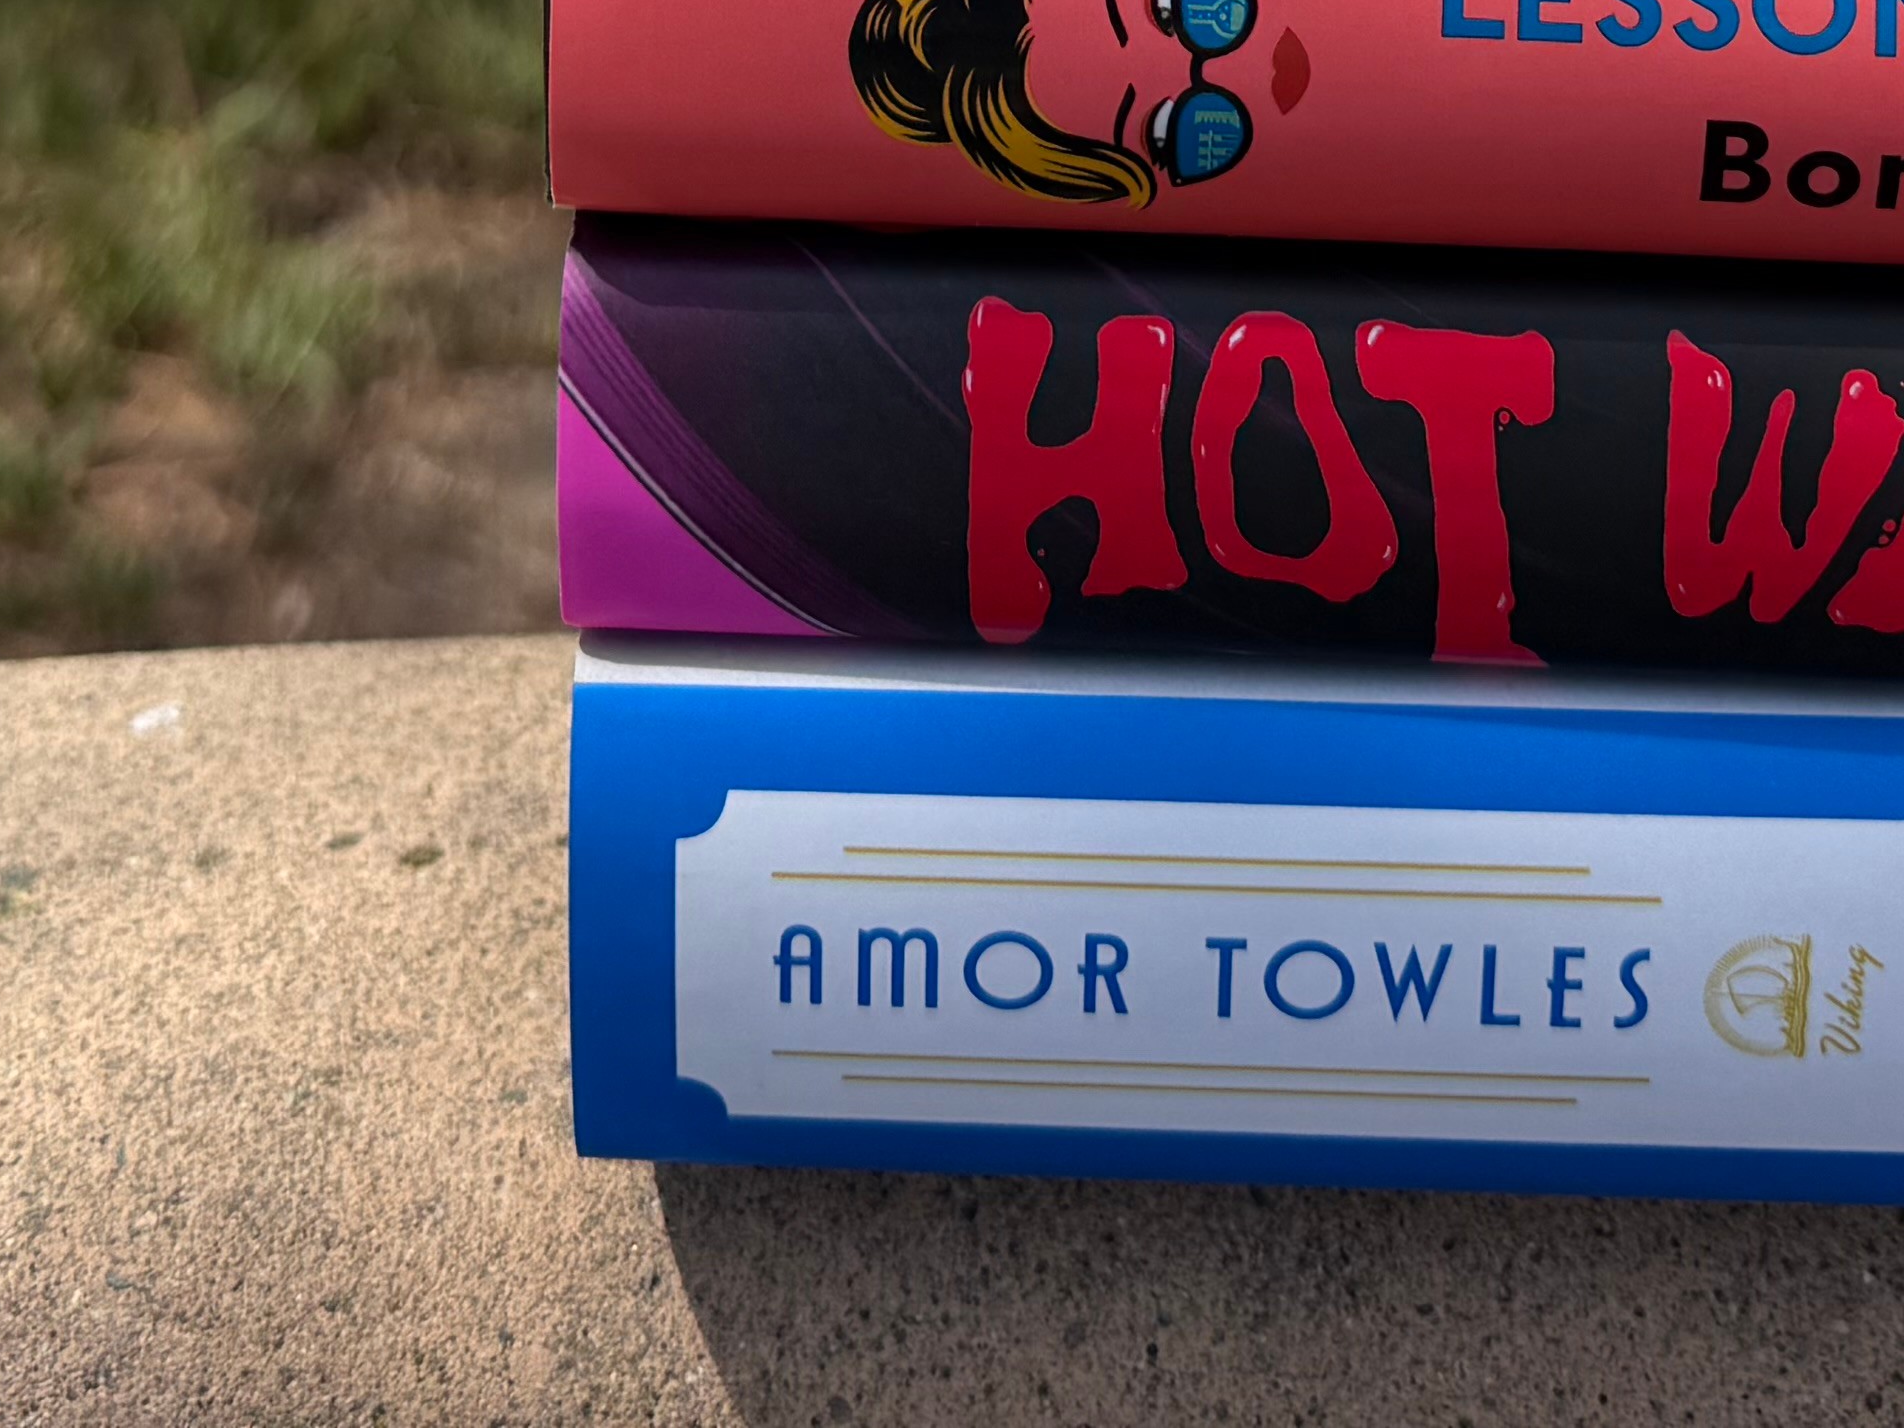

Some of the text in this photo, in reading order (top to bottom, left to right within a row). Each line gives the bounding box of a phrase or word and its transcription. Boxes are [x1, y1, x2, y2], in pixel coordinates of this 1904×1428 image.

[962, 295, 1555, 668] HOT
[771, 922, 1652, 1032] AMOR TOWLES
[1820, 942, 1884, 1057] Viking
